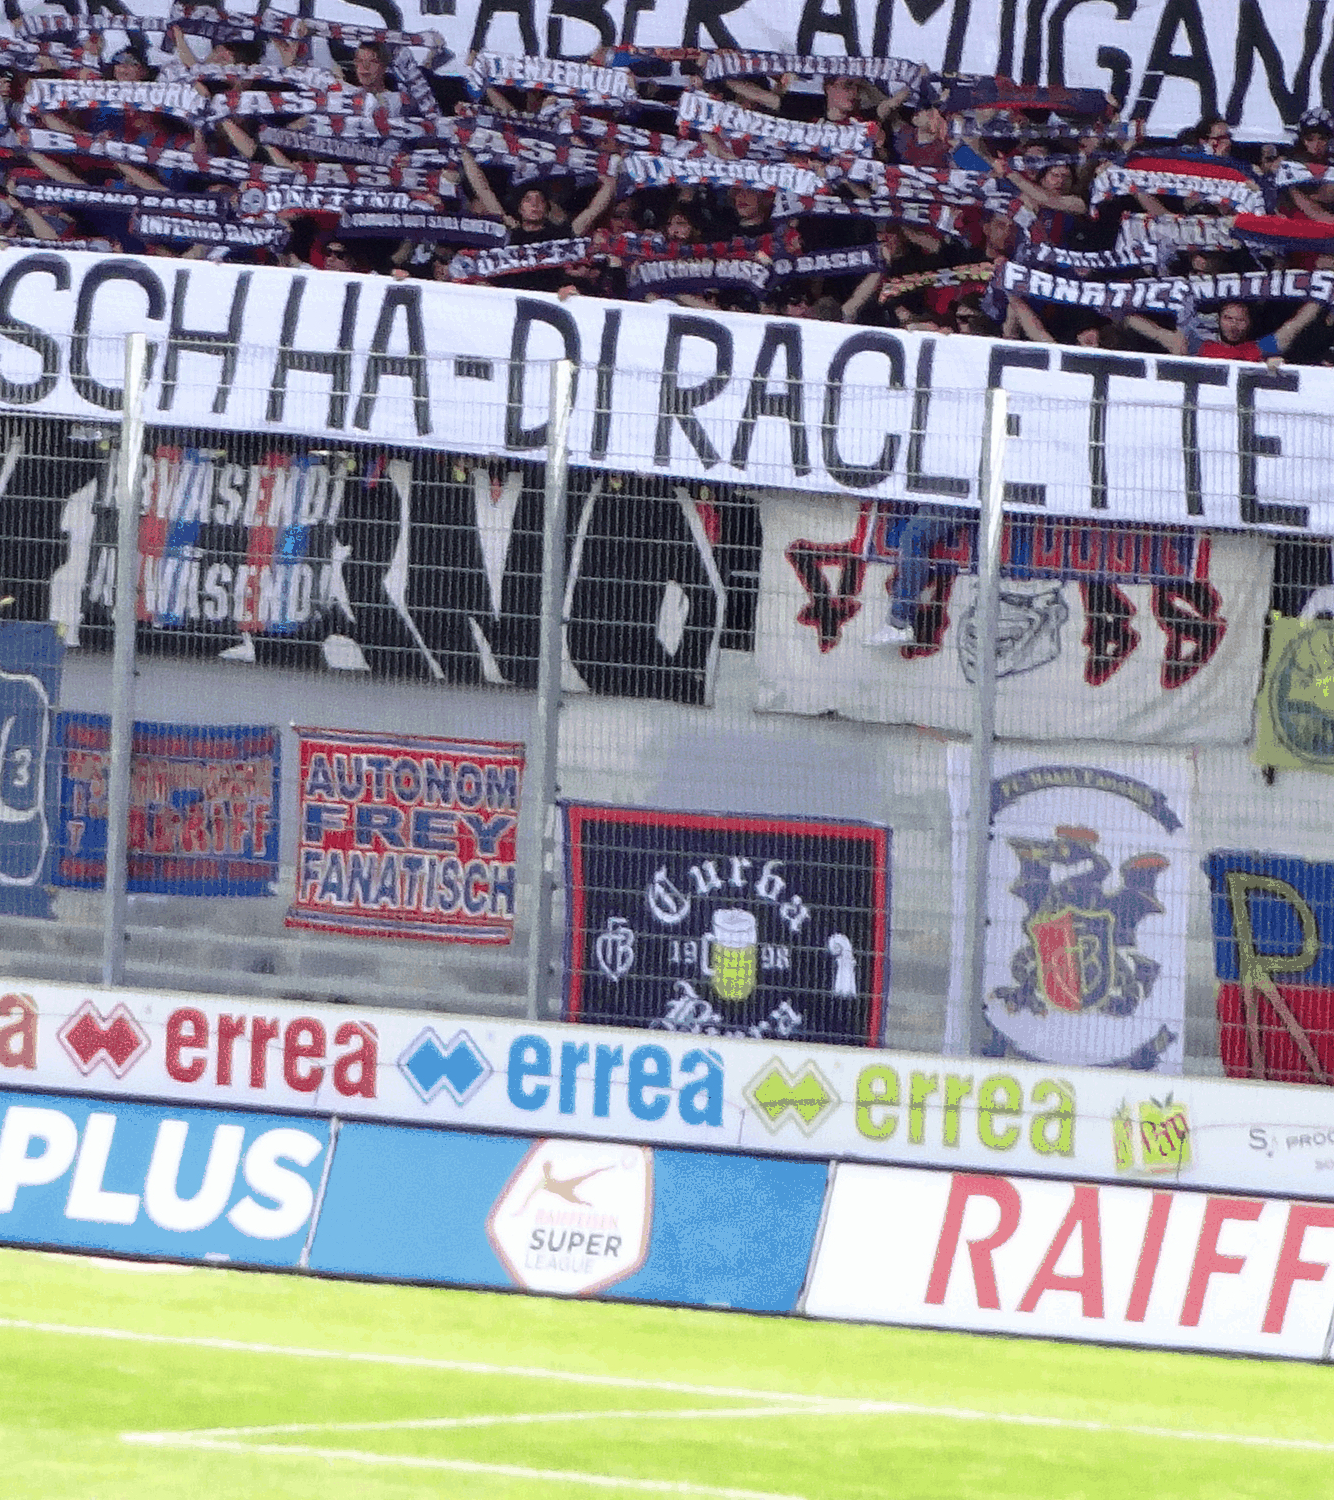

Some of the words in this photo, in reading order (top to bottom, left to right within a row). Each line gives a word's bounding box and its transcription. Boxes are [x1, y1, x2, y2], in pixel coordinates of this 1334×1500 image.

[654, 312, 1310, 527] RACLETTE
[307, 752, 520, 812] AUTONOM
[303, 802, 517, 858] FREY
[299, 847, 517, 919] FANATISCH
[528, 1227, 623, 1258] SUPER
